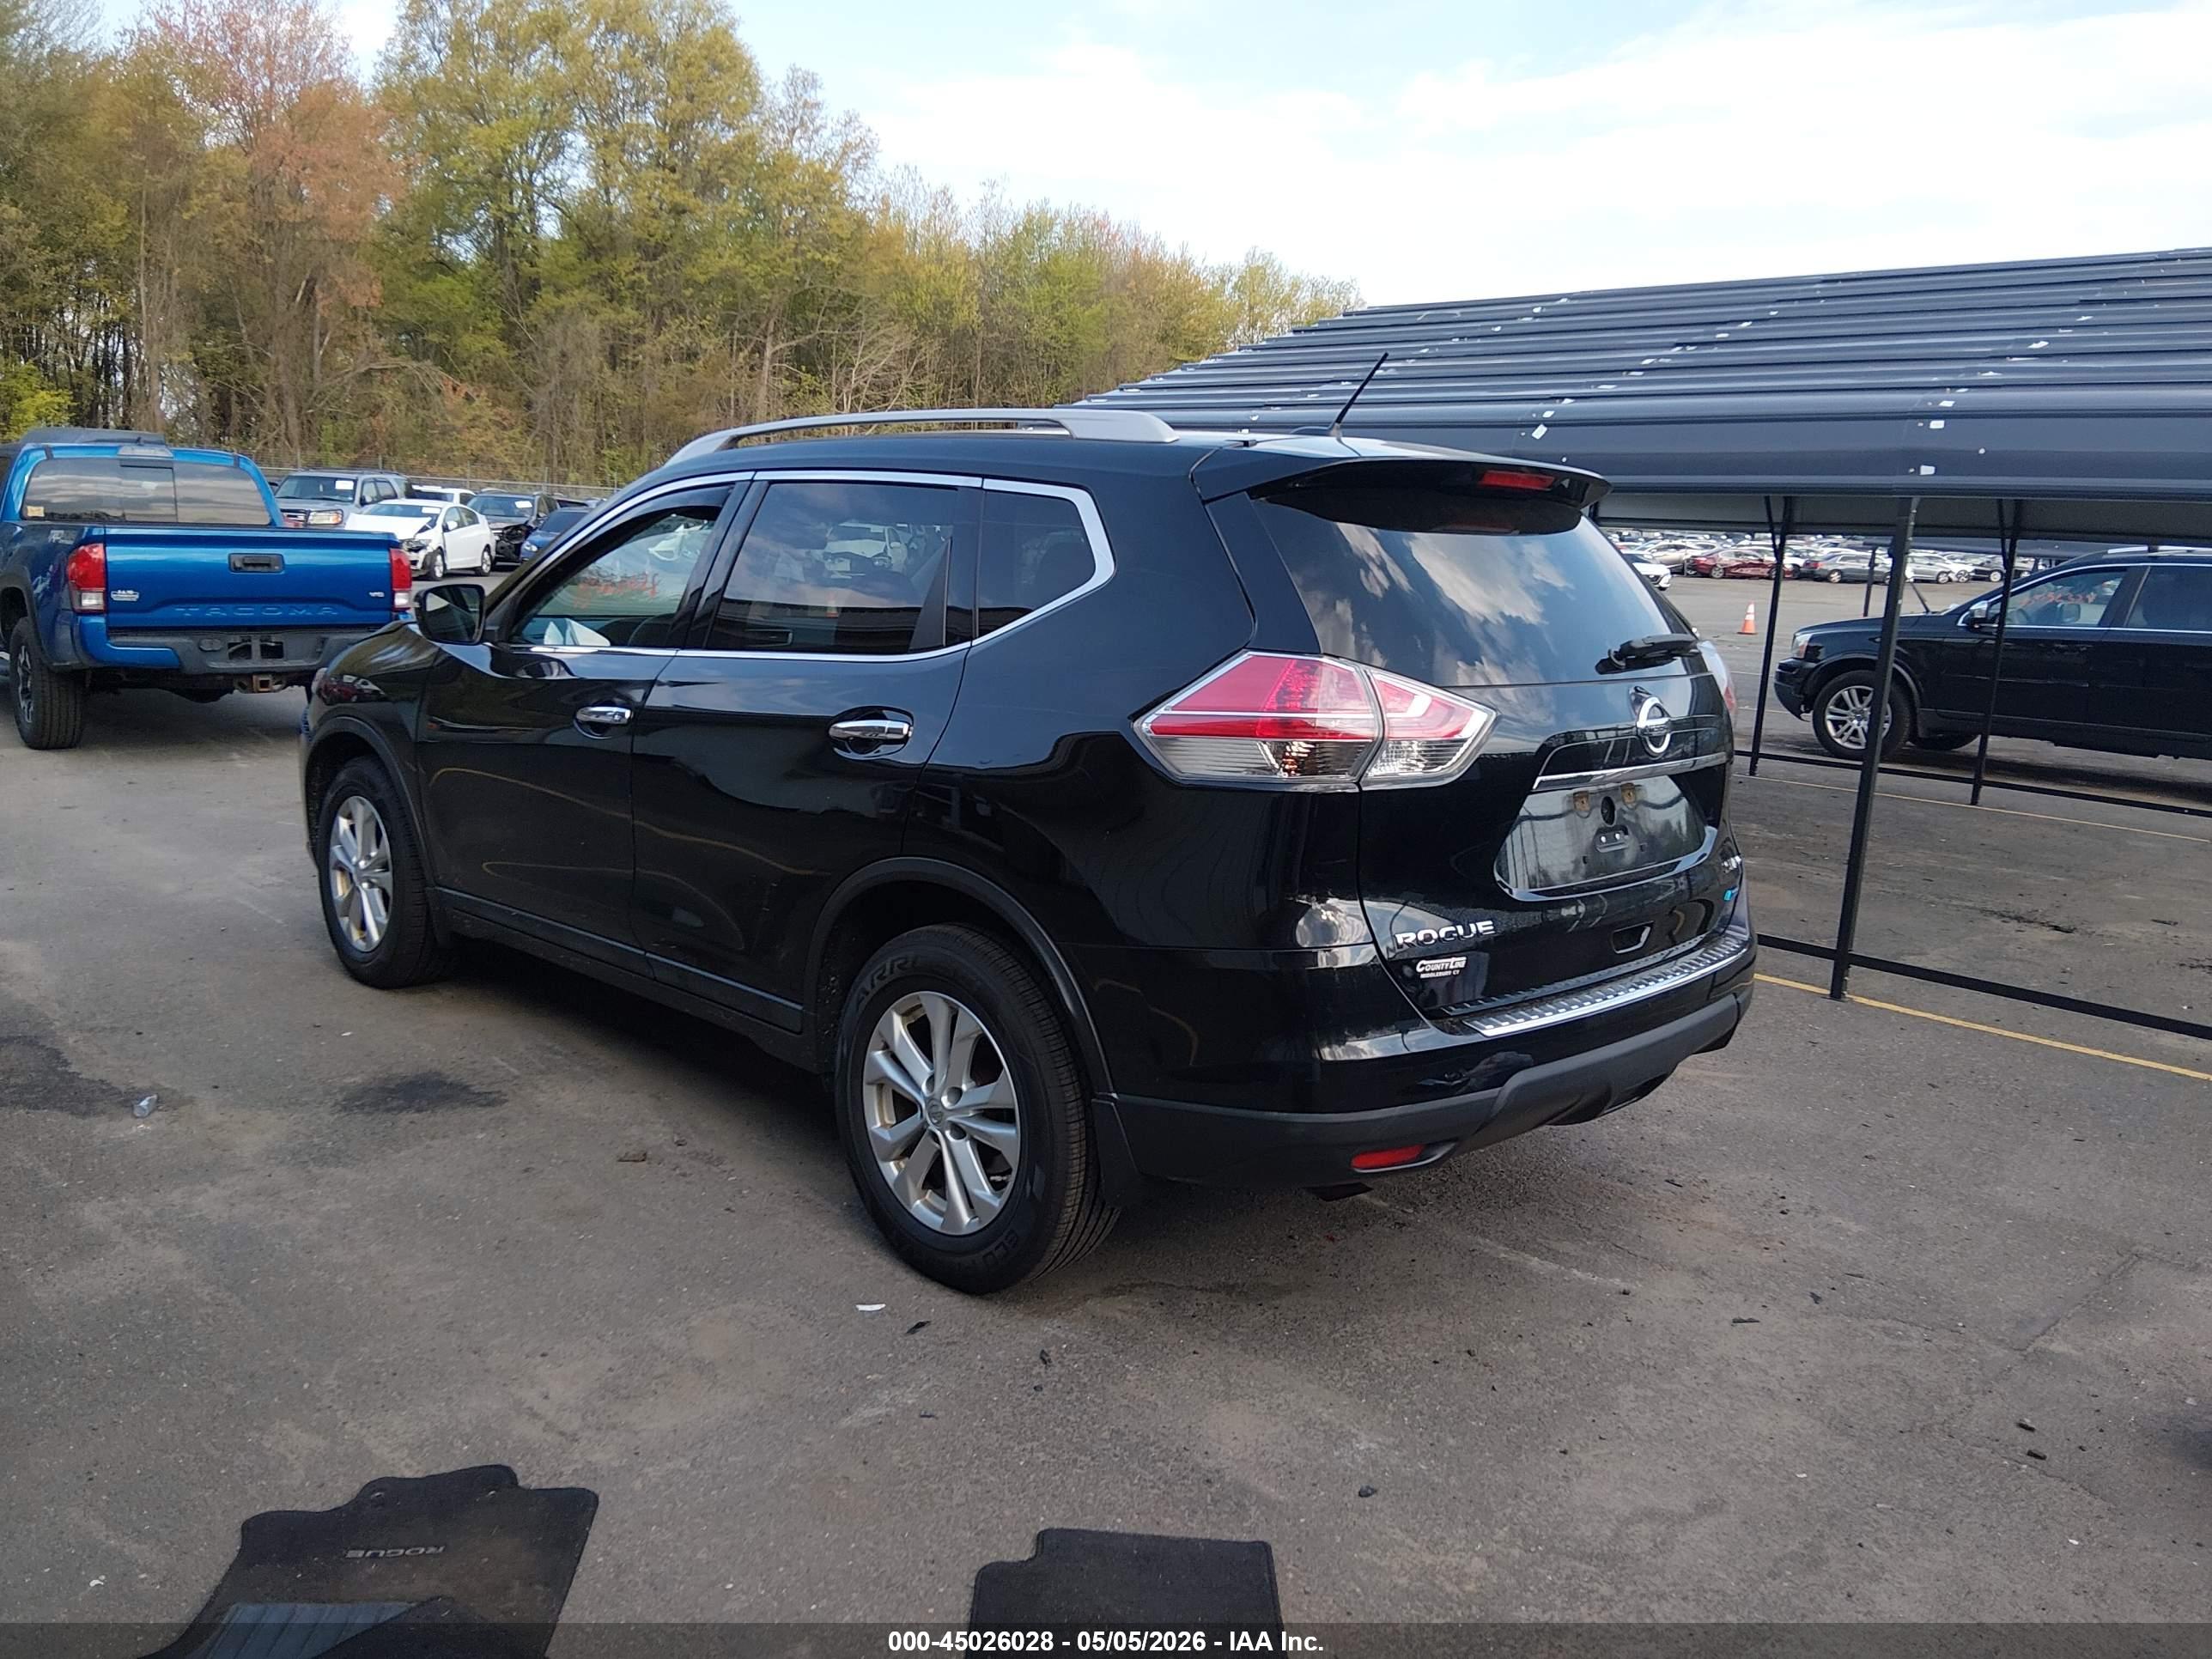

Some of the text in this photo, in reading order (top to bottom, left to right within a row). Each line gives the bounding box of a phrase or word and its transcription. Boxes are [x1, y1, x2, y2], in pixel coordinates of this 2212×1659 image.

[174, 606, 337, 617] TACOMA
[1395, 920, 1496, 949] ROGUE
[344, 1545, 446, 1559] ROGUE
